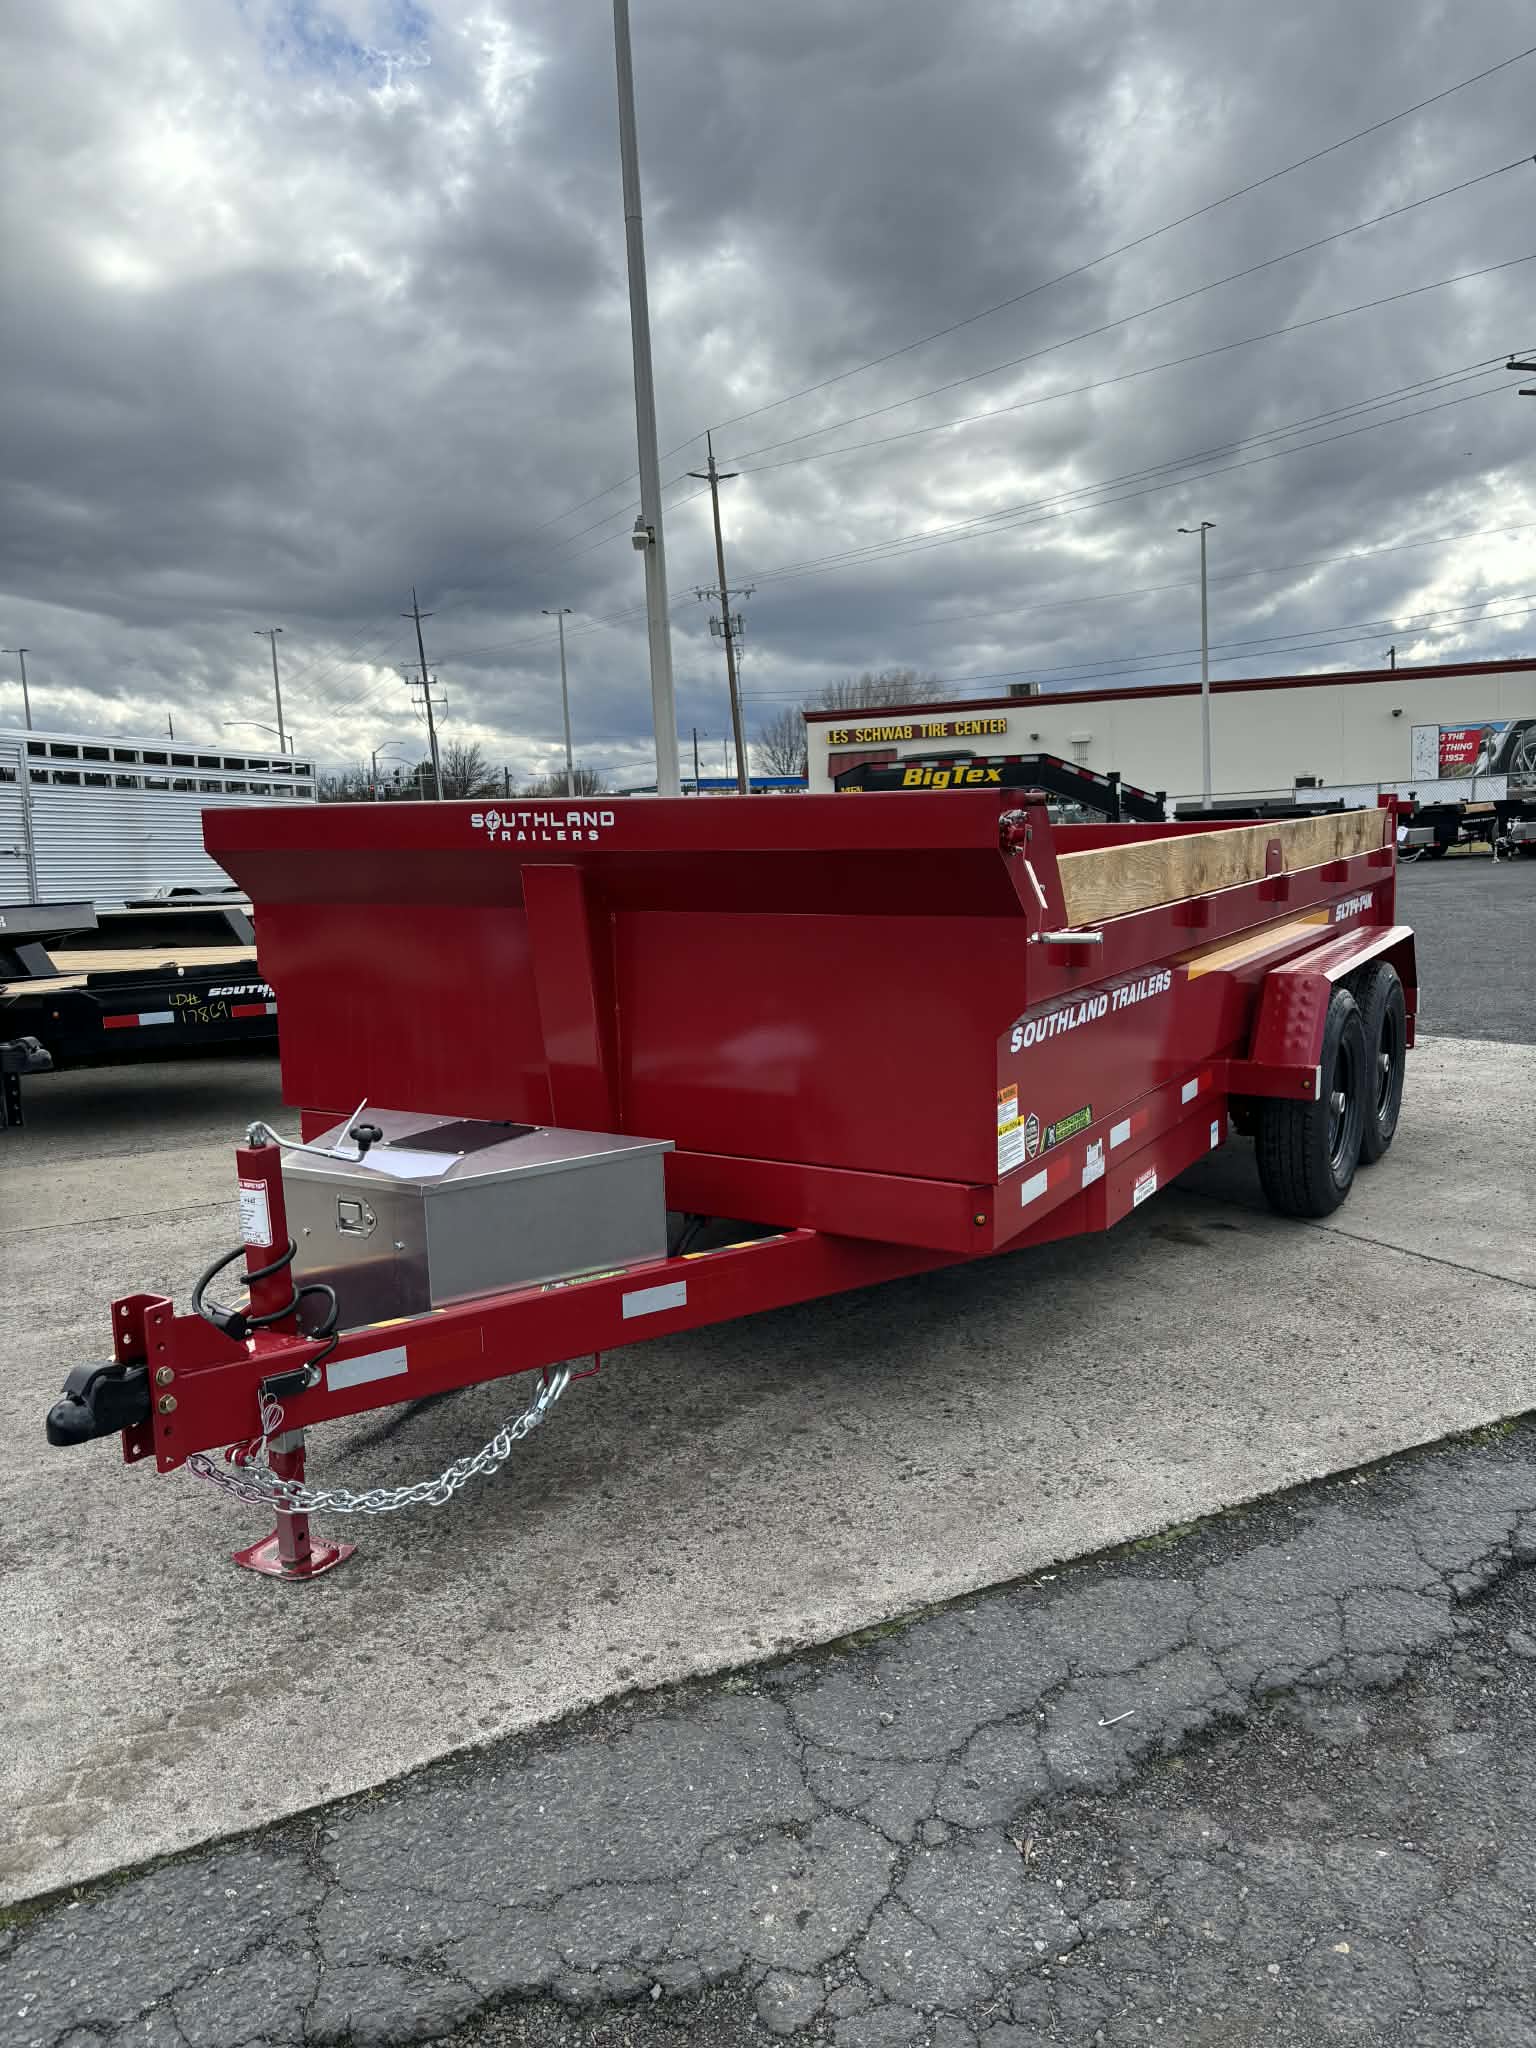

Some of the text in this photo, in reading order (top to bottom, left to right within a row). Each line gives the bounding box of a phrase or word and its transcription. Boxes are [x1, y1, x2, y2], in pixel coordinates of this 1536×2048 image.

[826, 718, 1007, 745] LES SCHWAB TIRE CENTER
[1447, 732, 1466, 742] THE
[1446, 742, 1473, 752] THING
[1445, 753, 1465, 762] 1952
[902, 765, 1003, 790] BigTex
[471, 809, 615, 830] SOUTHLAND
[487, 830, 600, 841] TRAILERS
[208, 984, 273, 997] SOUTH
[1010, 969, 1172, 1053] SOUTHLAND TRAILERS
